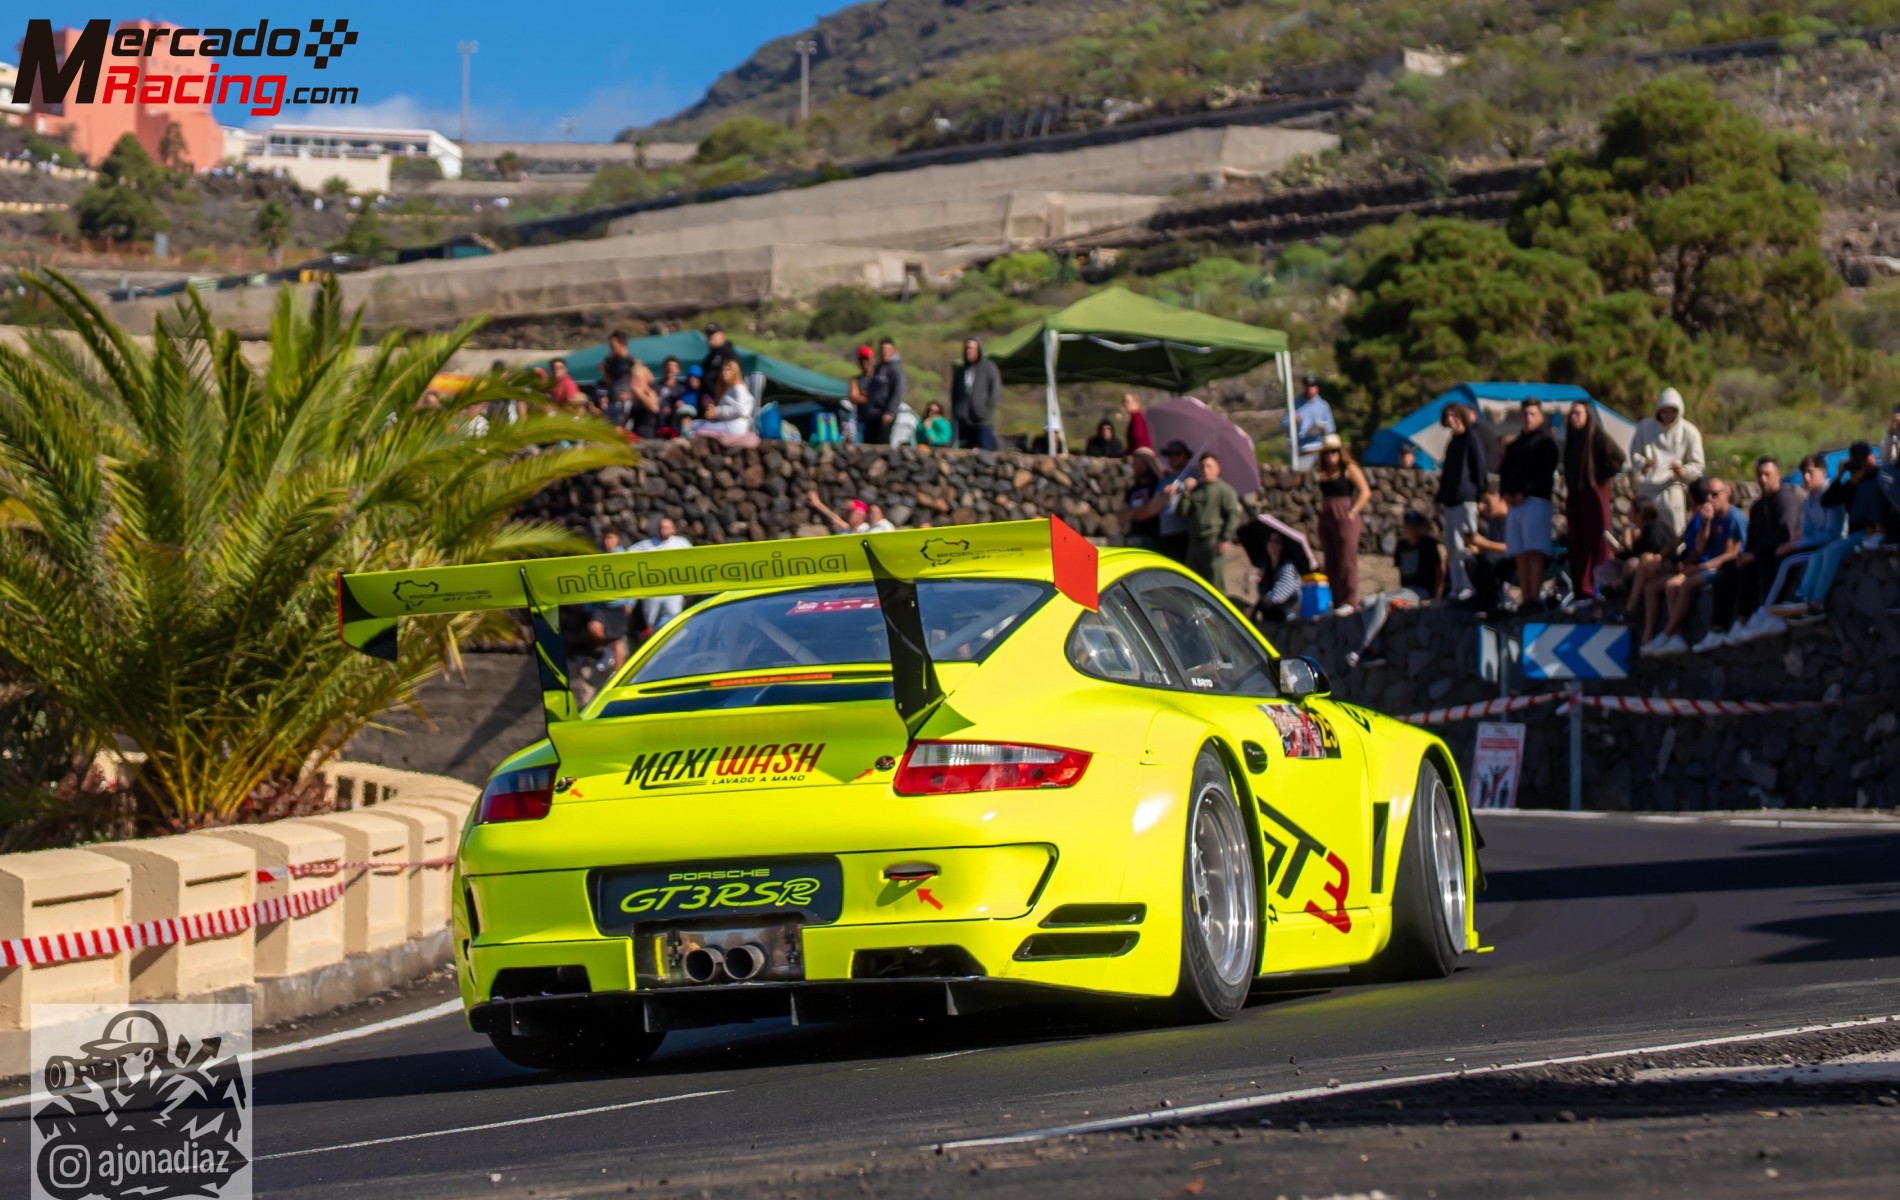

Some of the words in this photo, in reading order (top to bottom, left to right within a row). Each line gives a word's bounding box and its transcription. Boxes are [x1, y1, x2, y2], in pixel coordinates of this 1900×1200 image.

[557, 551, 848, 594] nürburgring
[712, 776, 755, 785] LAVADO
[760, 775, 768, 783] A
[772, 774, 806, 783] MANO
[668, 868, 771, 882] PORSCHE
